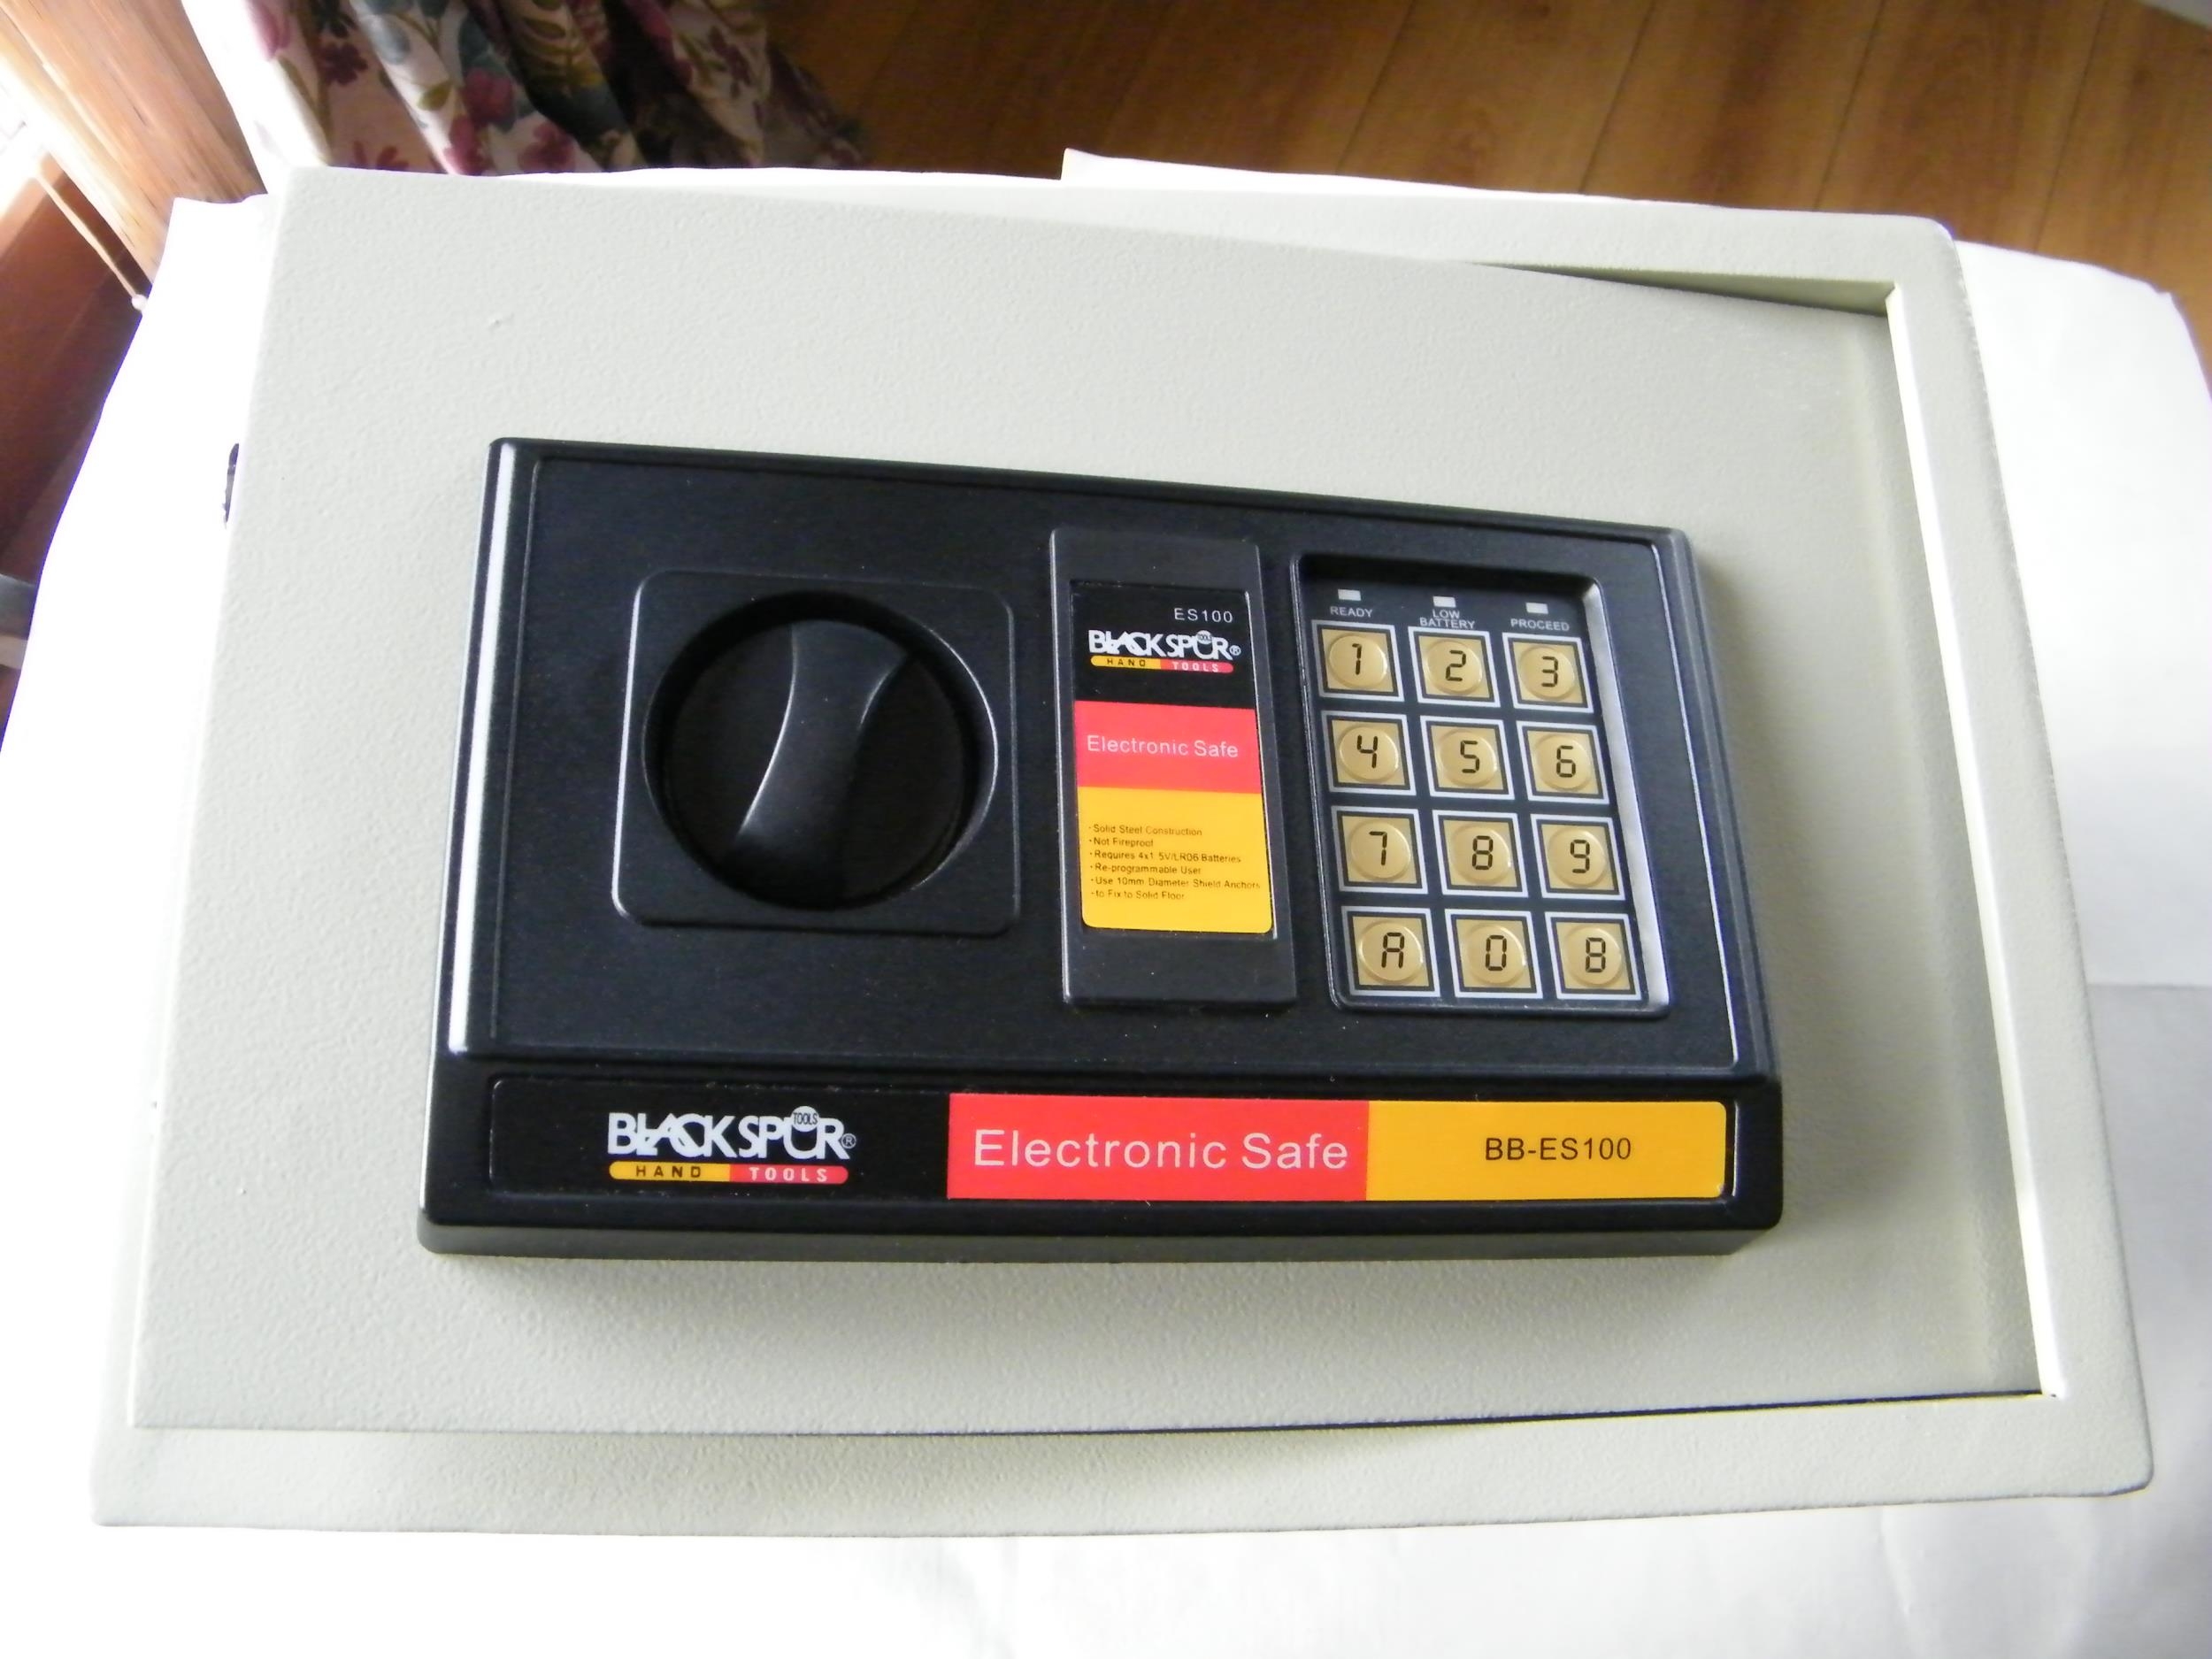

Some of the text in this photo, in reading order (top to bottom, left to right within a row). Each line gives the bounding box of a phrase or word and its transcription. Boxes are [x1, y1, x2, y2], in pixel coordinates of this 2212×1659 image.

[1174, 608, 1233, 623] ES100
[1330, 606, 1373, 618] READY
[1432, 609, 1460, 619] LOW
[1419, 617, 1475, 630] BATTERY
[1510, 618, 1571, 632] PROCEED
[1107, 658, 1219, 672] HAND TOOLS
[1351, 643, 1363, 676] 1
[1445, 649, 1466, 682] 2
[1541, 656, 1559, 687] 3
[1087, 735, 1239, 758] Electronic Safe
[1356, 734, 1379, 769] 4
[1460, 740, 1480, 774] 5
[1555, 745, 1577, 778] 6
[1094, 824, 1202, 836] Solid Steel Construction
[1094, 837, 1154, 848] Not Fireproof
[1369, 831, 1387, 866] 7
[1094, 849, 1135, 860] Requires
[1202, 853, 1241, 863] Batteries
[1471, 835, 1494, 871] 8
[1570, 839, 1591, 874] 9
[1094, 862, 1202, 875] Re-programmable User
[1095, 876, 1113, 885] Use
[1118, 877, 1145, 886] 10mm
[1148, 878, 1189, 887] Diameter
[1108, 888, 1121, 897] Fix
[1124, 890, 1133, 899] to
[1136, 890, 1158, 900] Solid
[1162, 890, 1185, 900] Floor
[1380, 932, 1405, 969] A
[1485, 934, 1508, 972] 0
[793, 1112, 818, 1125] TOOLS
[974, 1129, 1348, 1170] Electronic Safe
[1485, 1137, 1632, 1161] BB-ES100
[635, 1165, 827, 1183] HAND TOOLS
